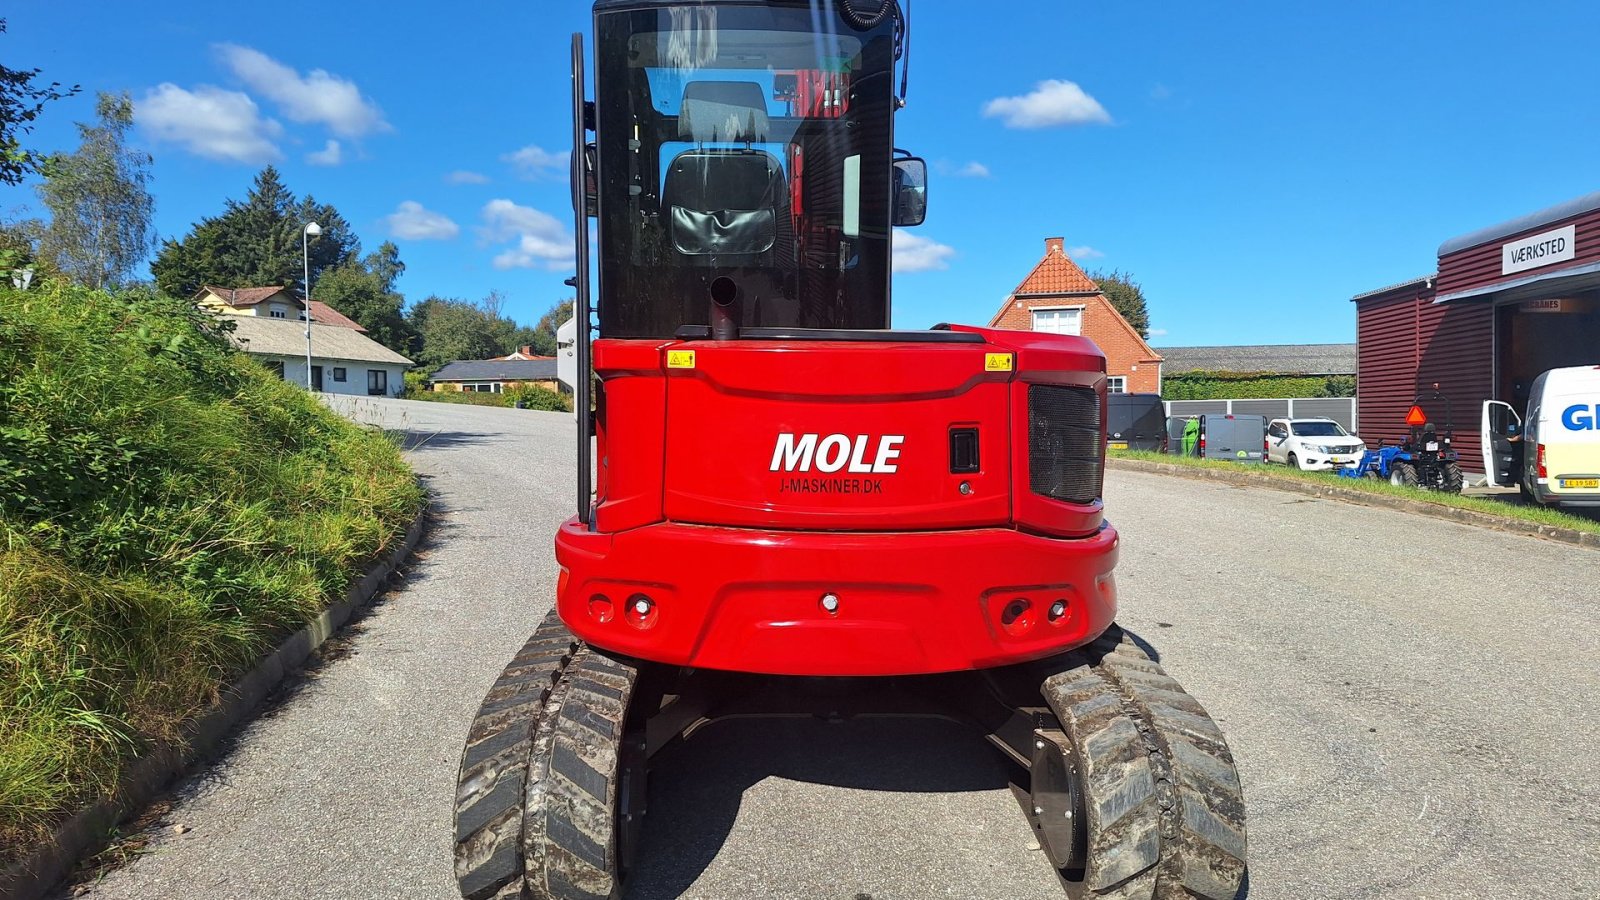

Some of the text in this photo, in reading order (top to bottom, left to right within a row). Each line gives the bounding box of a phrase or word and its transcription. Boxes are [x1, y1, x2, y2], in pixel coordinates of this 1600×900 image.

[1511, 237, 1566, 264] VÆRKSTED
[769, 433, 905, 473] MOLE
[780, 479, 882, 493] J-MASKINER.DK
